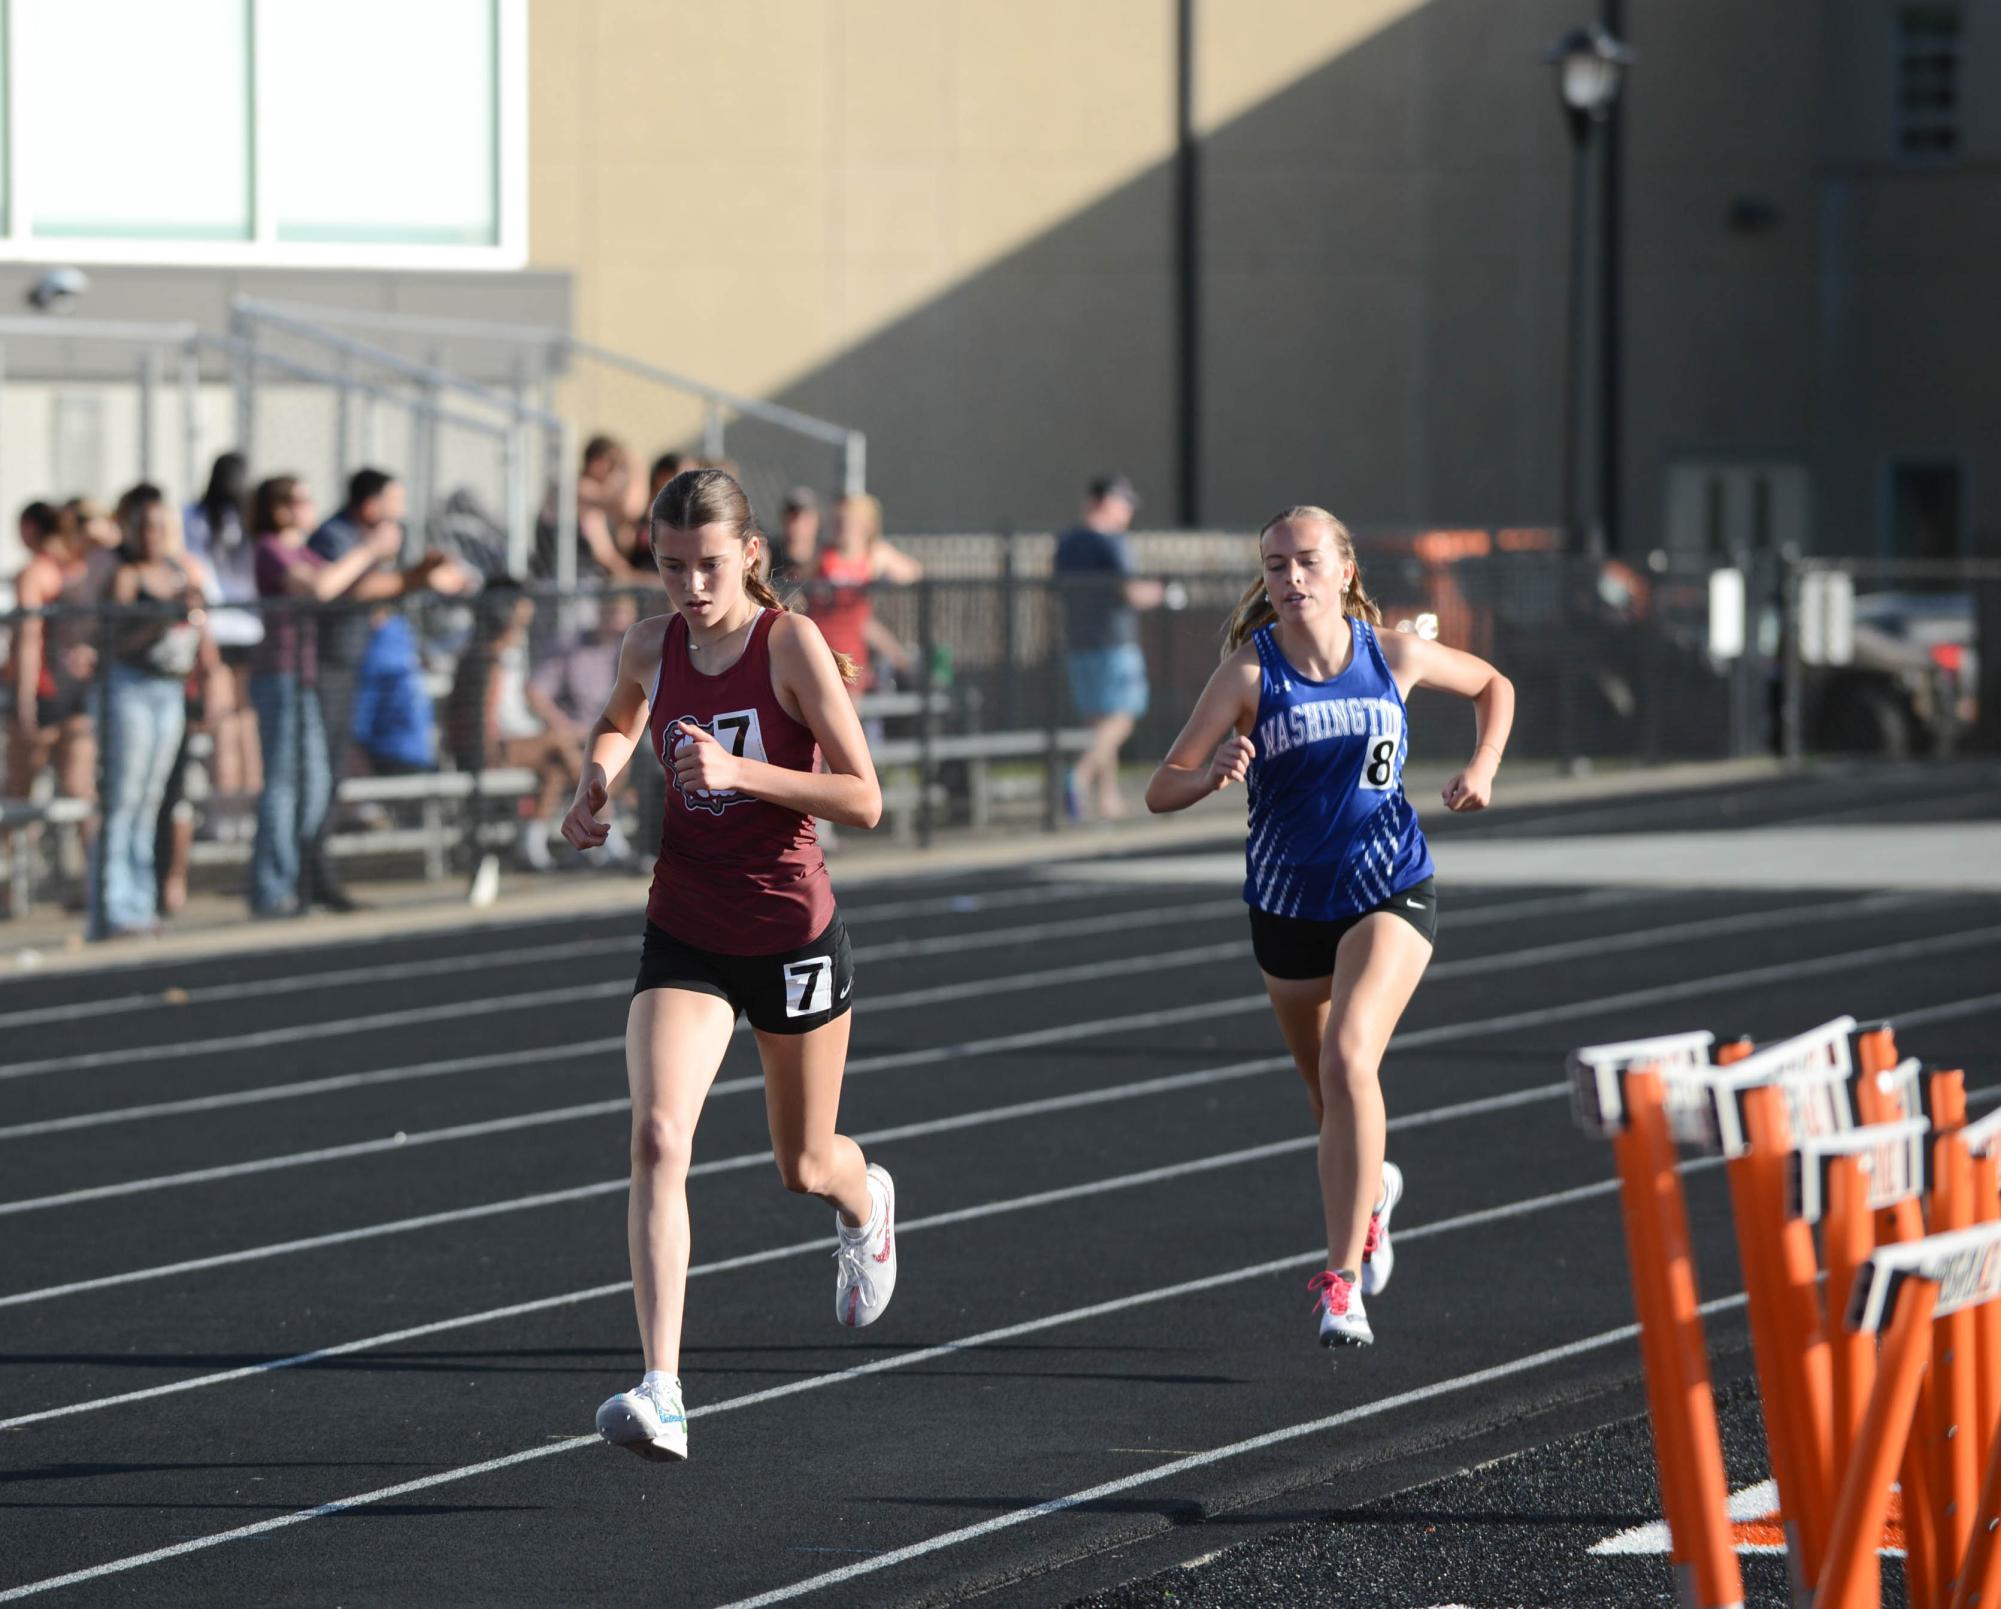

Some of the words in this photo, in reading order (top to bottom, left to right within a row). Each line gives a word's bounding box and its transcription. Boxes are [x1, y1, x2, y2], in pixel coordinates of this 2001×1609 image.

[717, 715, 750, 757] 7
[1367, 741, 1394, 786] 8
[790, 962, 824, 1010] 7
